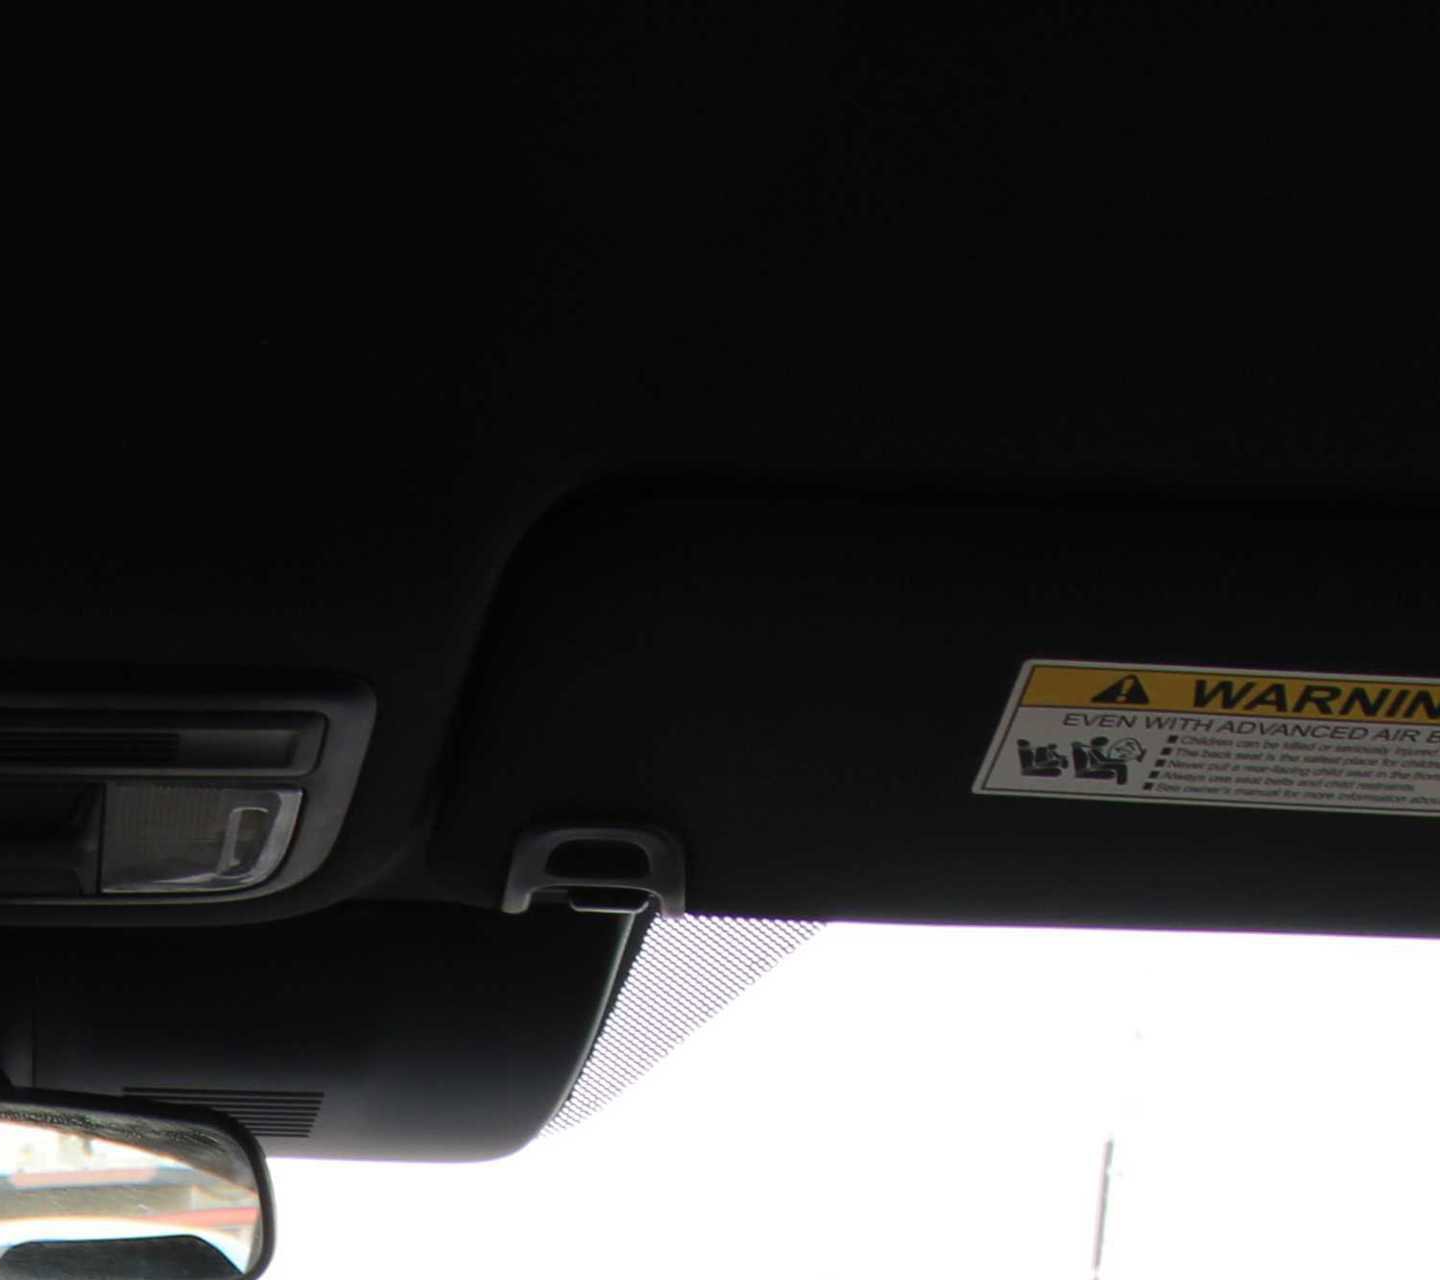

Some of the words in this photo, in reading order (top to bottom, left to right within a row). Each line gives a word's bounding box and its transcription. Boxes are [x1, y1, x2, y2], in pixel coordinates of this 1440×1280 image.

[1062, 712, 1137, 729] EVEN
[1144, 716, 1213, 733] WITH
[1216, 719, 1369, 741] ADVANCED
[1371, 727, 1421, 743] AIR
